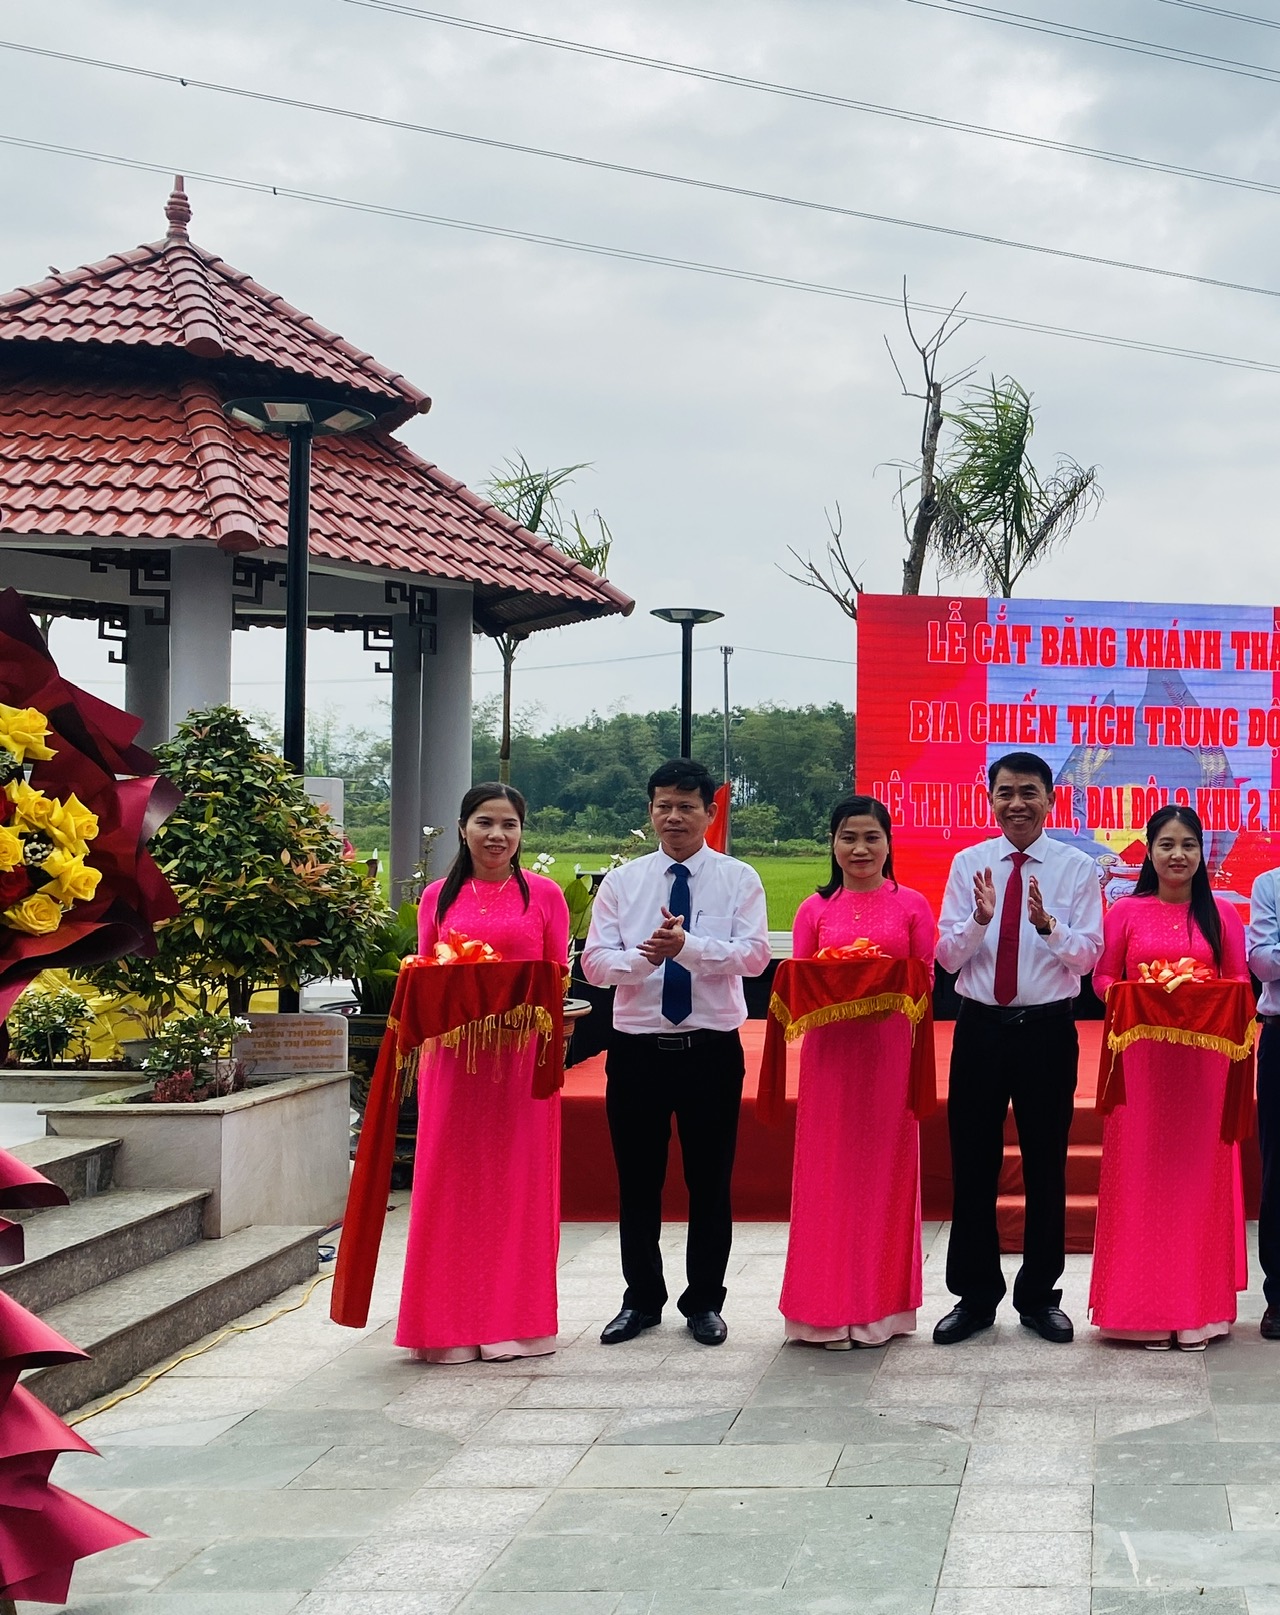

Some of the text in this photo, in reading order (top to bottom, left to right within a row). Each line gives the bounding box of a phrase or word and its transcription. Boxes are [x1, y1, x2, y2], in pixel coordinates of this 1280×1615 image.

[927, 601, 966, 663] LỄ
[973, 604, 1031, 664] CẮT
[1040, 616, 1116, 667] BĂNG
[1125, 619, 1222, 670] KHÁNH
[909, 700, 962, 743] BIA
[969, 688, 1058, 744] CHIẾN
[1067, 695, 1136, 747] TÍCH
[1143, 705, 1239, 748] TRUNG
[910, 782, 951, 840] THỊ
[1086, 786, 1125, 842] ĐẠI
[1196, 787, 1240, 832] KHU
[1246, 788, 1262, 834] 2
